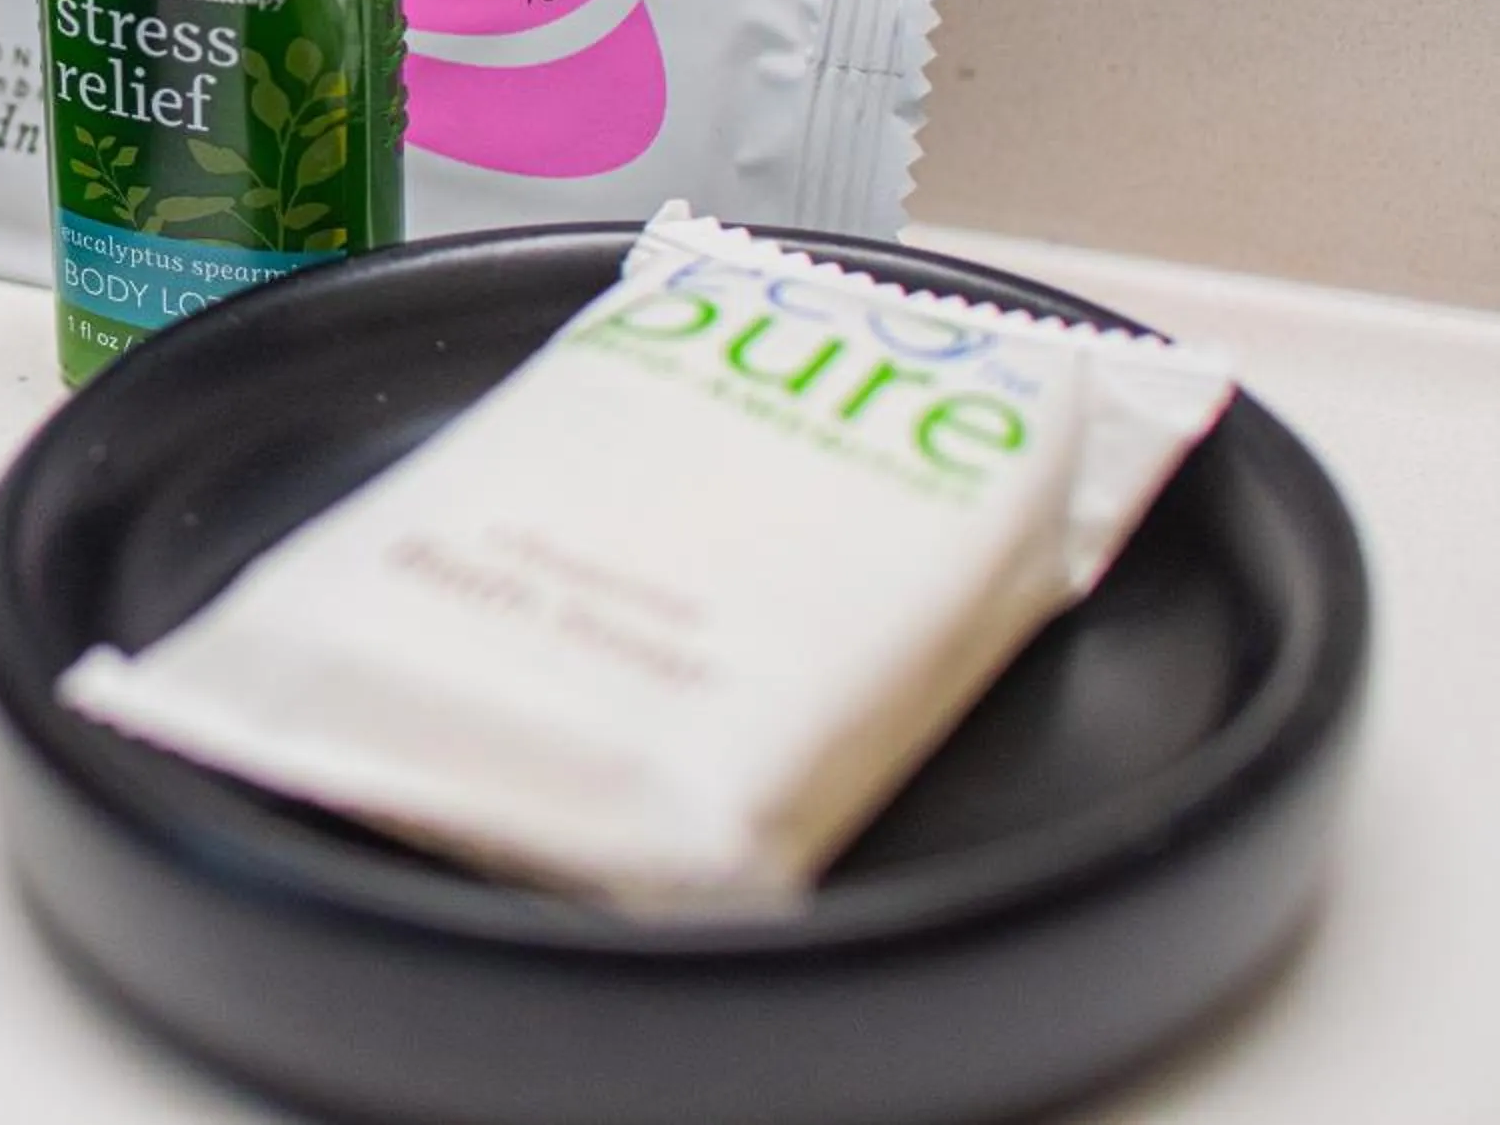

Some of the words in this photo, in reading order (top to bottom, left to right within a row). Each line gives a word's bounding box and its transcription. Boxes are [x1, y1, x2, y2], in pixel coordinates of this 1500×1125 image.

[56, 58, 217, 132] relief
[59, 225, 183, 273] eucalyptus
[64, 259, 149, 309] BODY
[162, 287, 223, 316] LO
[81, 320, 91, 341] fl
[97, 332, 119, 351] oz
